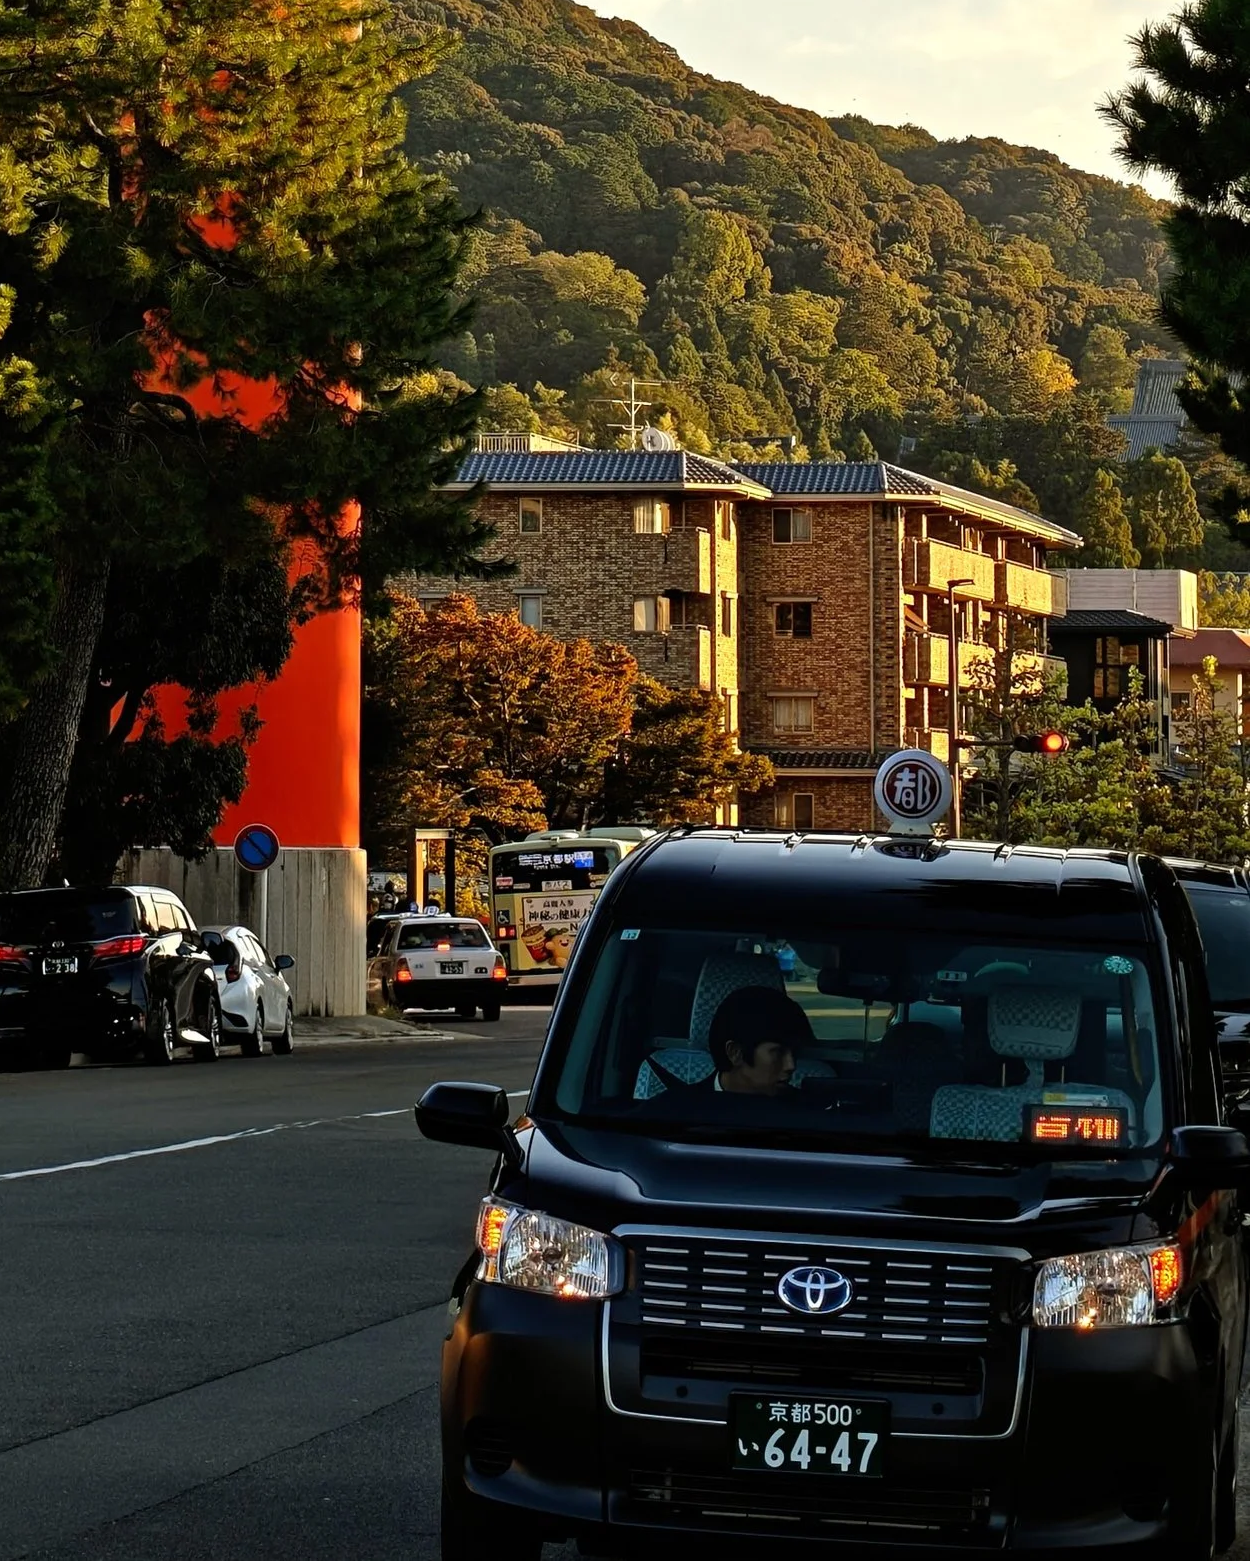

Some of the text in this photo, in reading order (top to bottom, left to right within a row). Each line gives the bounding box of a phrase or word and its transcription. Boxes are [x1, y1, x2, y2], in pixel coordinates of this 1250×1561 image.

[894, 767, 930, 809] 都
[768, 1401, 853, 1426] 京都500
[764, 1428, 879, 1473] 64-47
